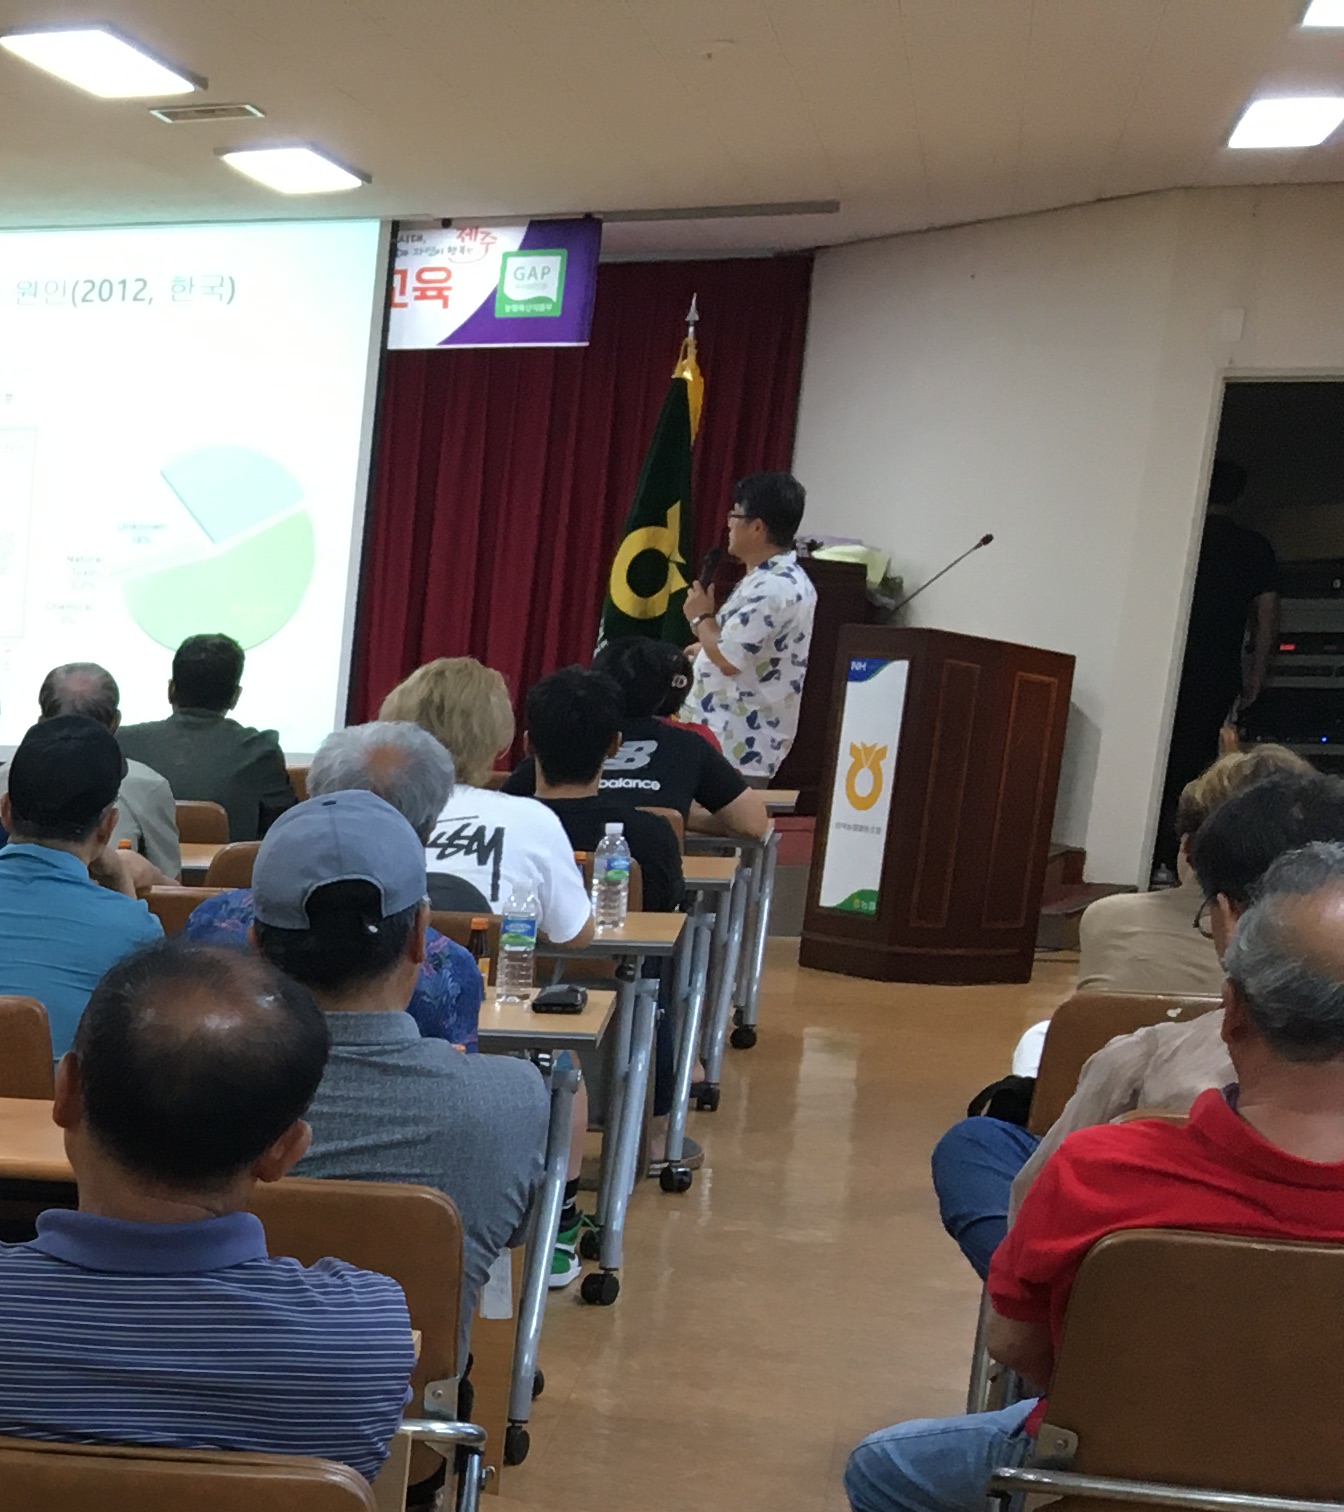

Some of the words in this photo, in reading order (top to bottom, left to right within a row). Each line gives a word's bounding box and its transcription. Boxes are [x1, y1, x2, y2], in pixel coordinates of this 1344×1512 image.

[514, 265, 552, 281] GAP
[14, 276, 155, 309] 원인(2012,
[170, 273, 237, 306] 한국)
